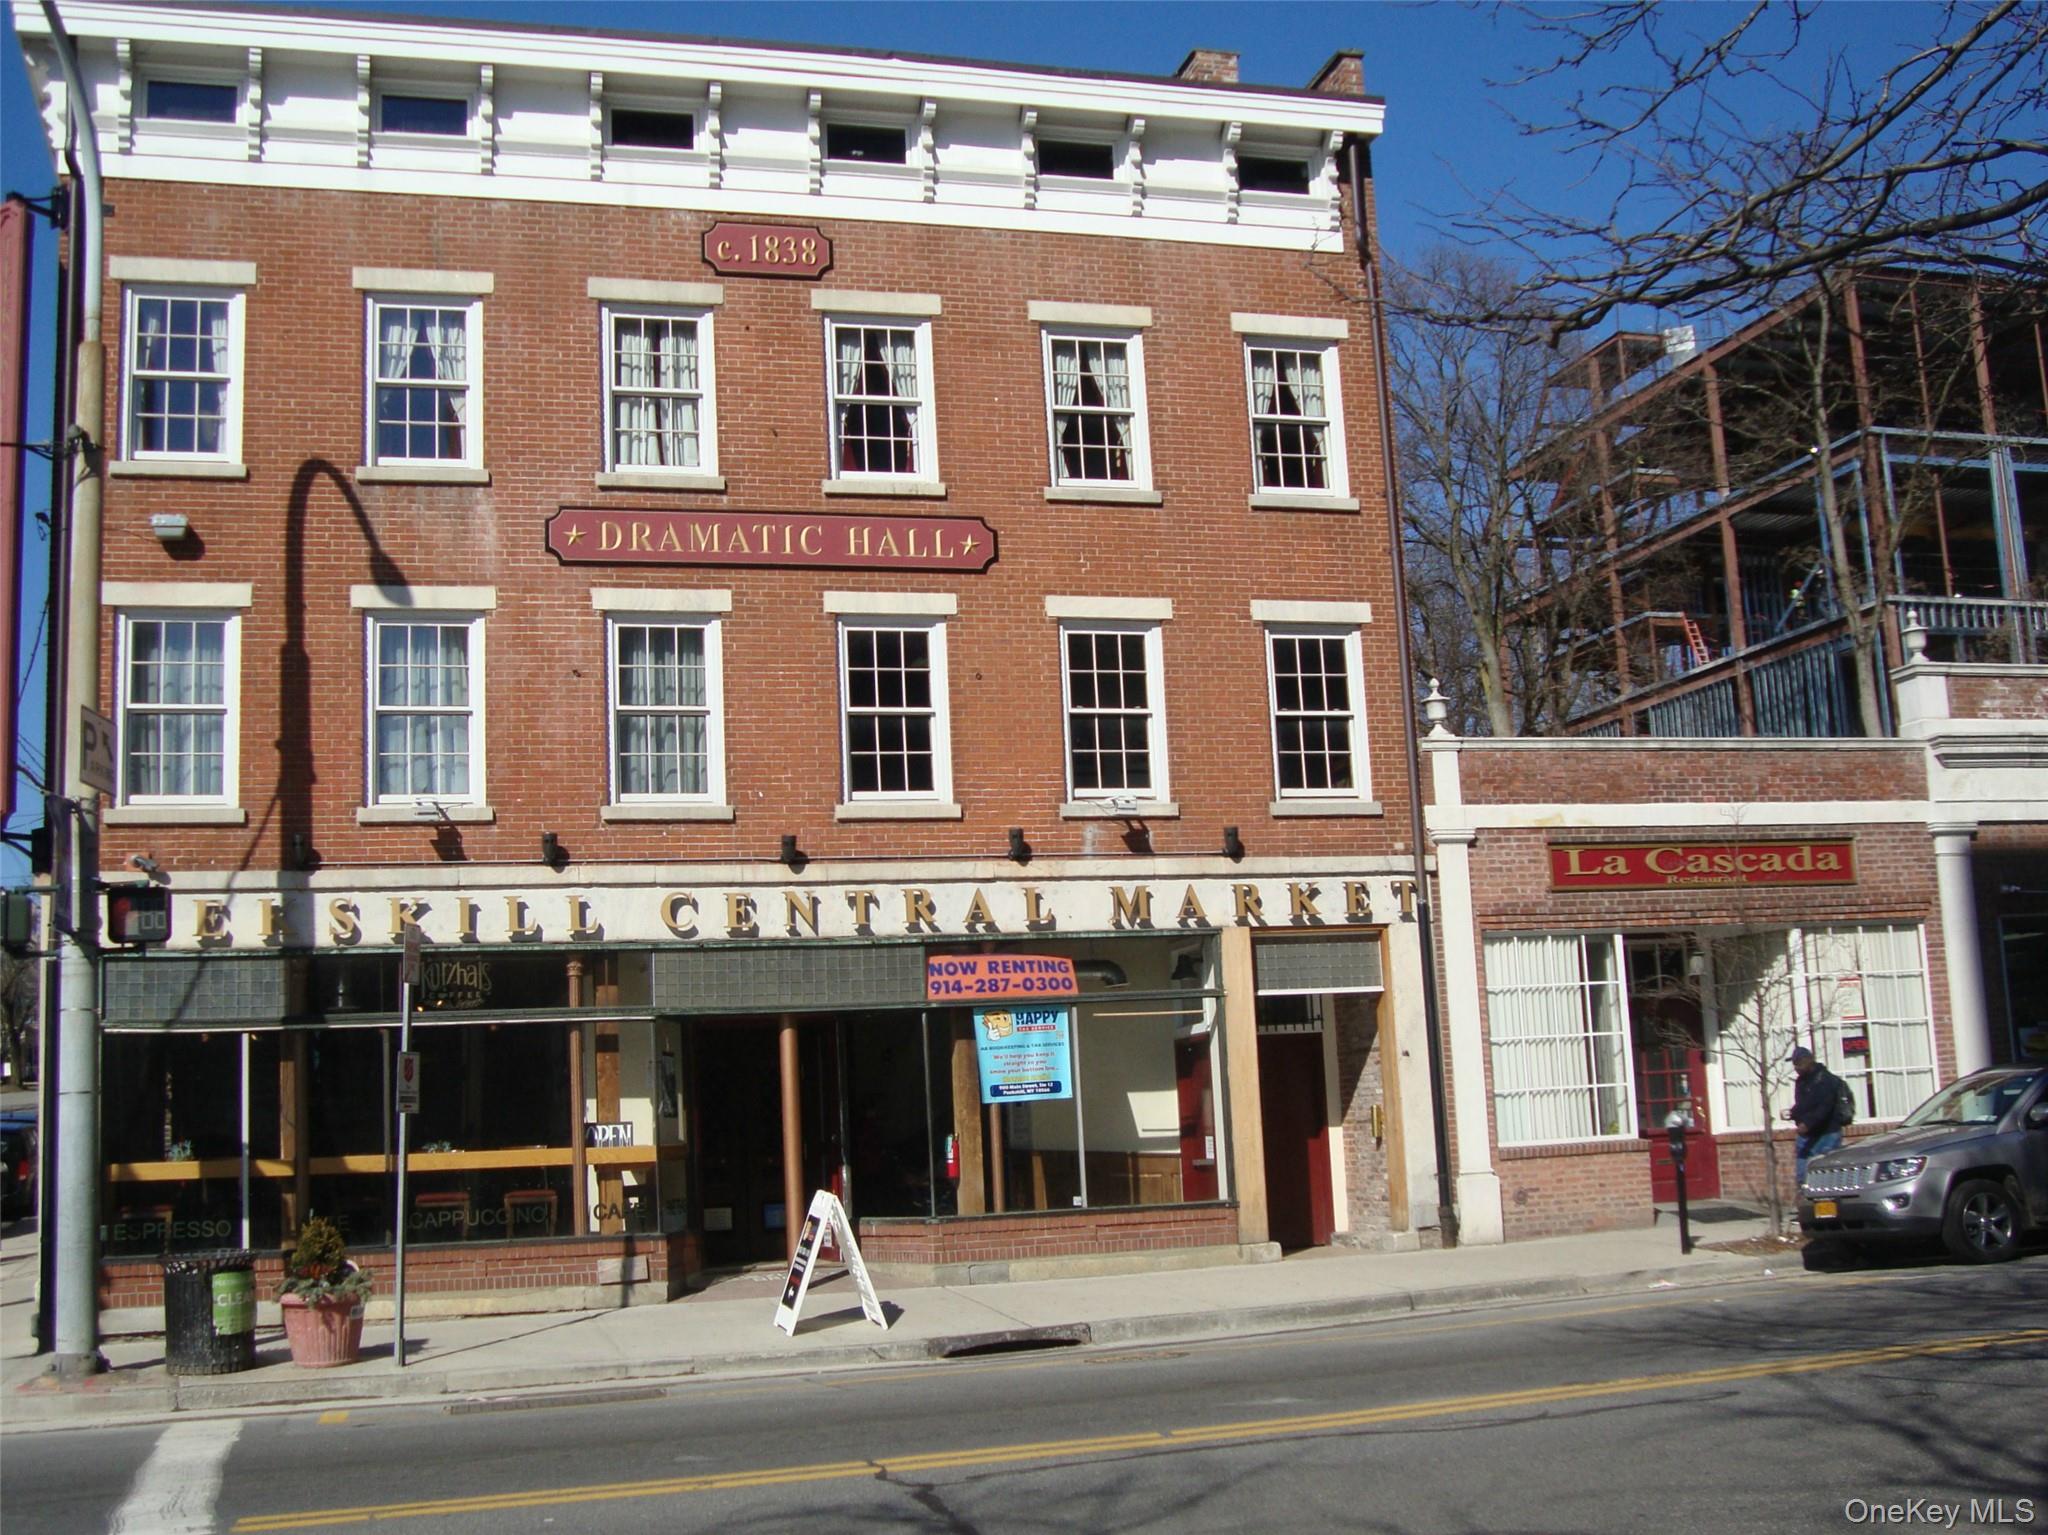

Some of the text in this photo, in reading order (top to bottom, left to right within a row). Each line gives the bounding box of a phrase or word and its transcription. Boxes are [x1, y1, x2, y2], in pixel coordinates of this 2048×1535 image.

[717, 234, 817, 266] c. 1838
[598, 520, 954, 558] DRAMATIC HALL
[1563, 846, 1843, 877] La Cascada
[1667, 874, 1749, 885] Restaurant
[659, 886, 1053, 931] CENTRAL
[1108, 880, 1418, 920] MARKET
[928, 960, 1070, 977] NOW RENTING
[929, 976, 1074, 995] 914-287-0300
[1015, 1010, 1059, 1026] HAPPY
[586, 1123, 633, 1147] OPEN
[113, 1219, 232, 1241] ESPRESSO
[407, 1206, 547, 1230] CAPPUCCINO
